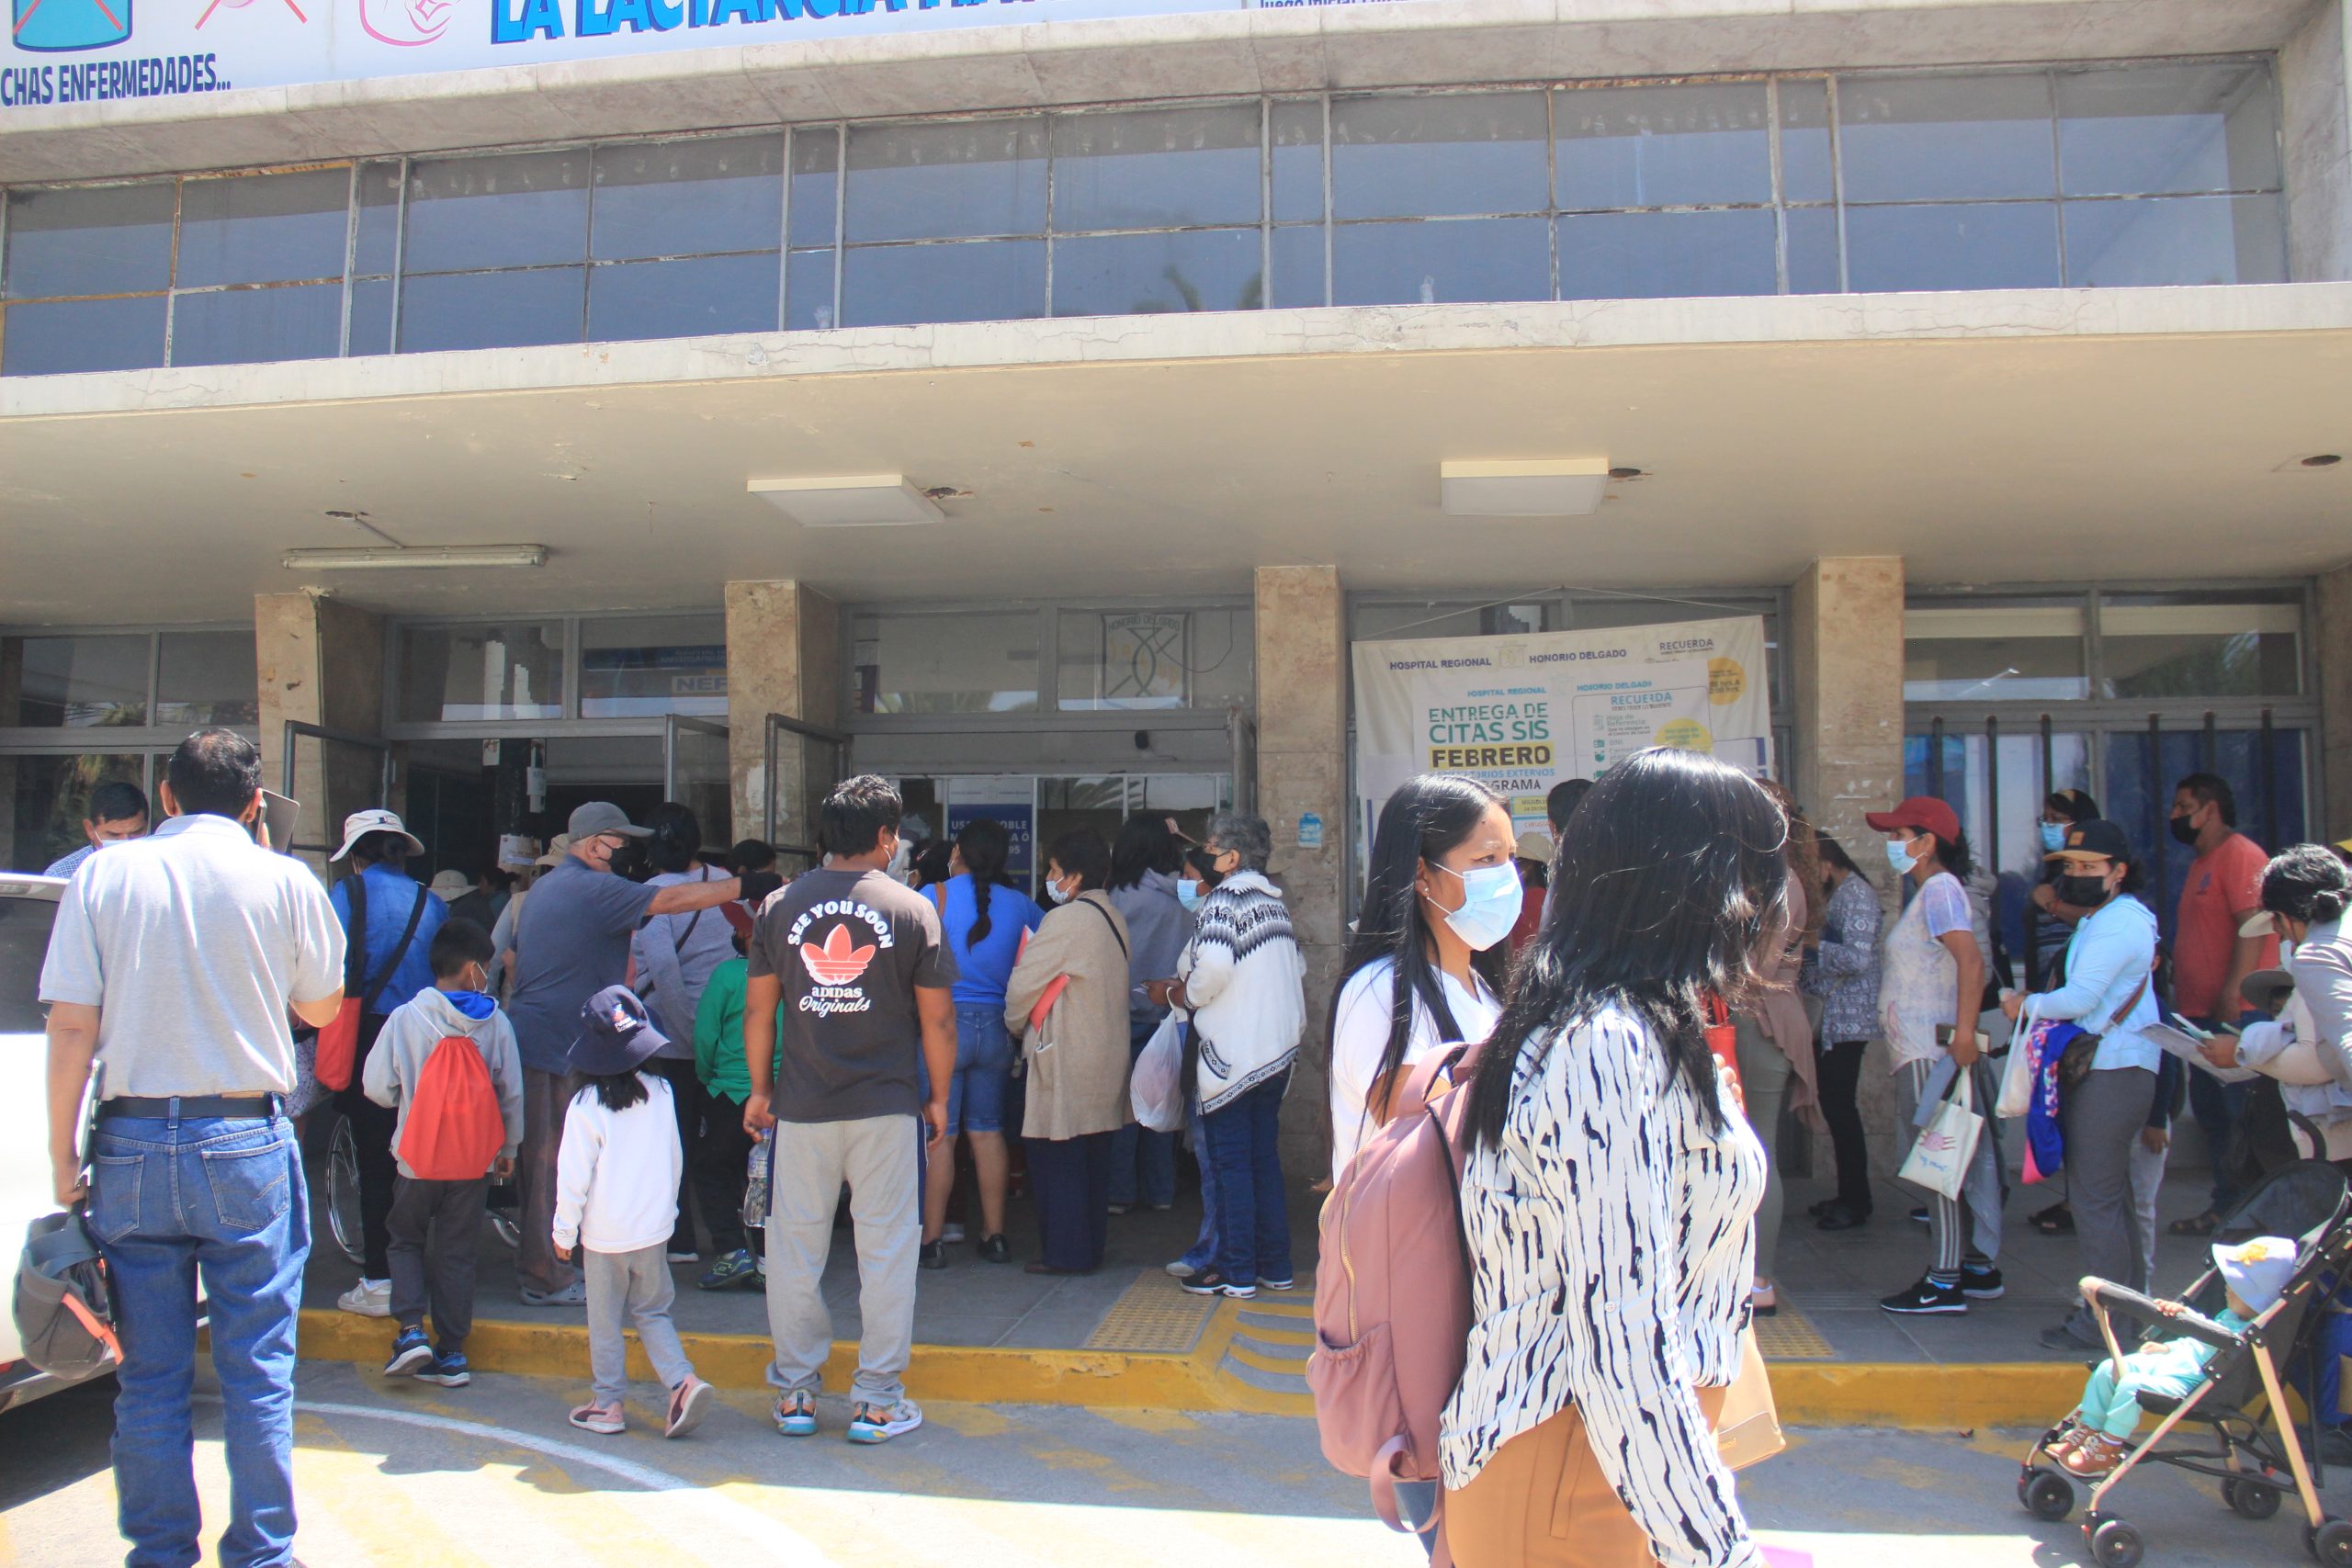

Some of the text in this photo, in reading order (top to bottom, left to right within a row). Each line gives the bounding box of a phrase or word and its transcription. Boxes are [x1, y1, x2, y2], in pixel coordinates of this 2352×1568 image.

[1, 53, 231, 107] CHAS ENFERMEDADES...
[1659, 638, 1713, 650] RECUERDA
[1389, 649, 1627, 671] HOSPITAL REGIONAL HONORIO DELGADO
[1429, 703, 1549, 722] ENTREGA DE
[1429, 719, 1550, 743] CITAS SIS
[1431, 745, 1551, 768] FEBRERO
[1507, 768, 1555, 778] EXTERNOS
[787, 900, 894, 949] SEE YOU SOON
[799, 997, 871, 1018] Originals
